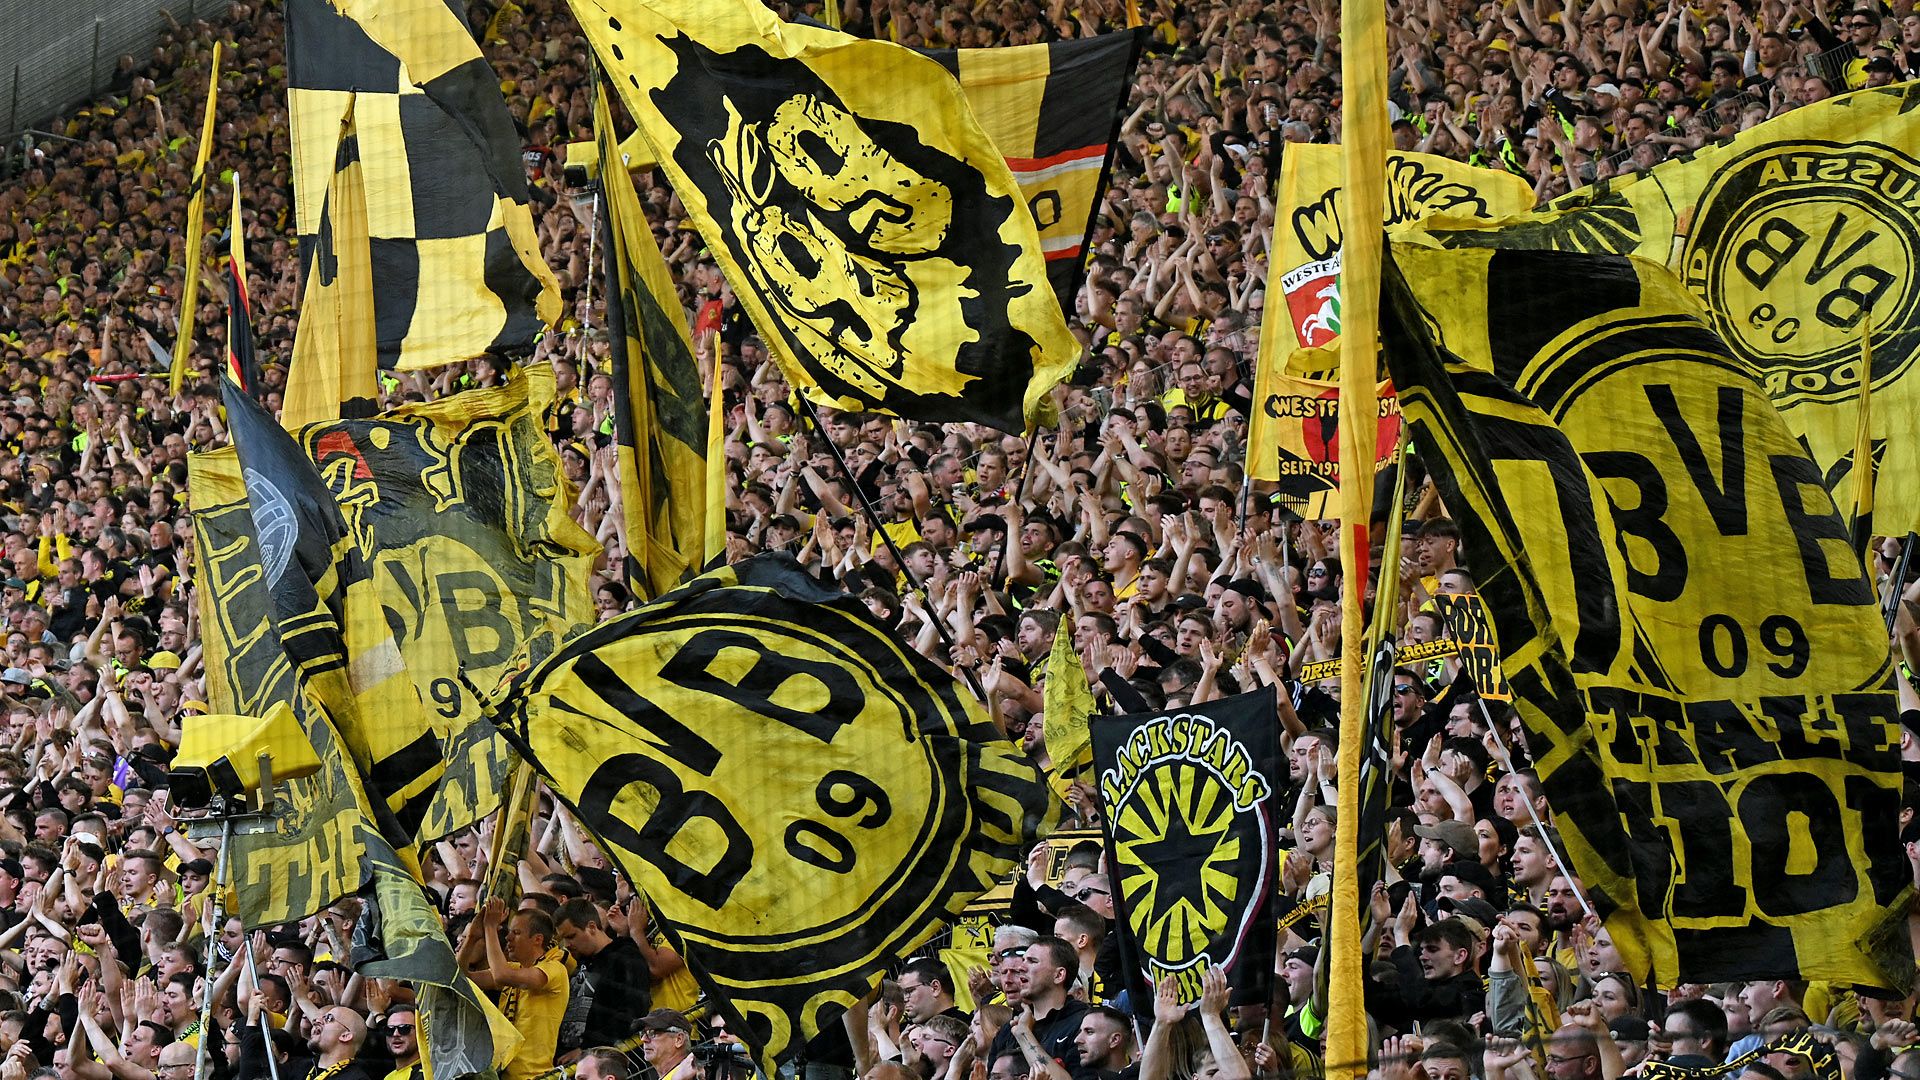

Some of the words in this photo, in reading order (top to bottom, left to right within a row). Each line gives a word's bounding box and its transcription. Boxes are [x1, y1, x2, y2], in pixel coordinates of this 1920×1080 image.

[1283, 260, 1340, 288] WESTFA
[1280, 460, 1313, 475] SEIT
[1318, 460, 1340, 476] 197
[1579, 384, 1876, 606] BVB
[1699, 613, 1810, 680] 09
[549, 629, 866, 912] BVB
[783, 769, 892, 875] 09
